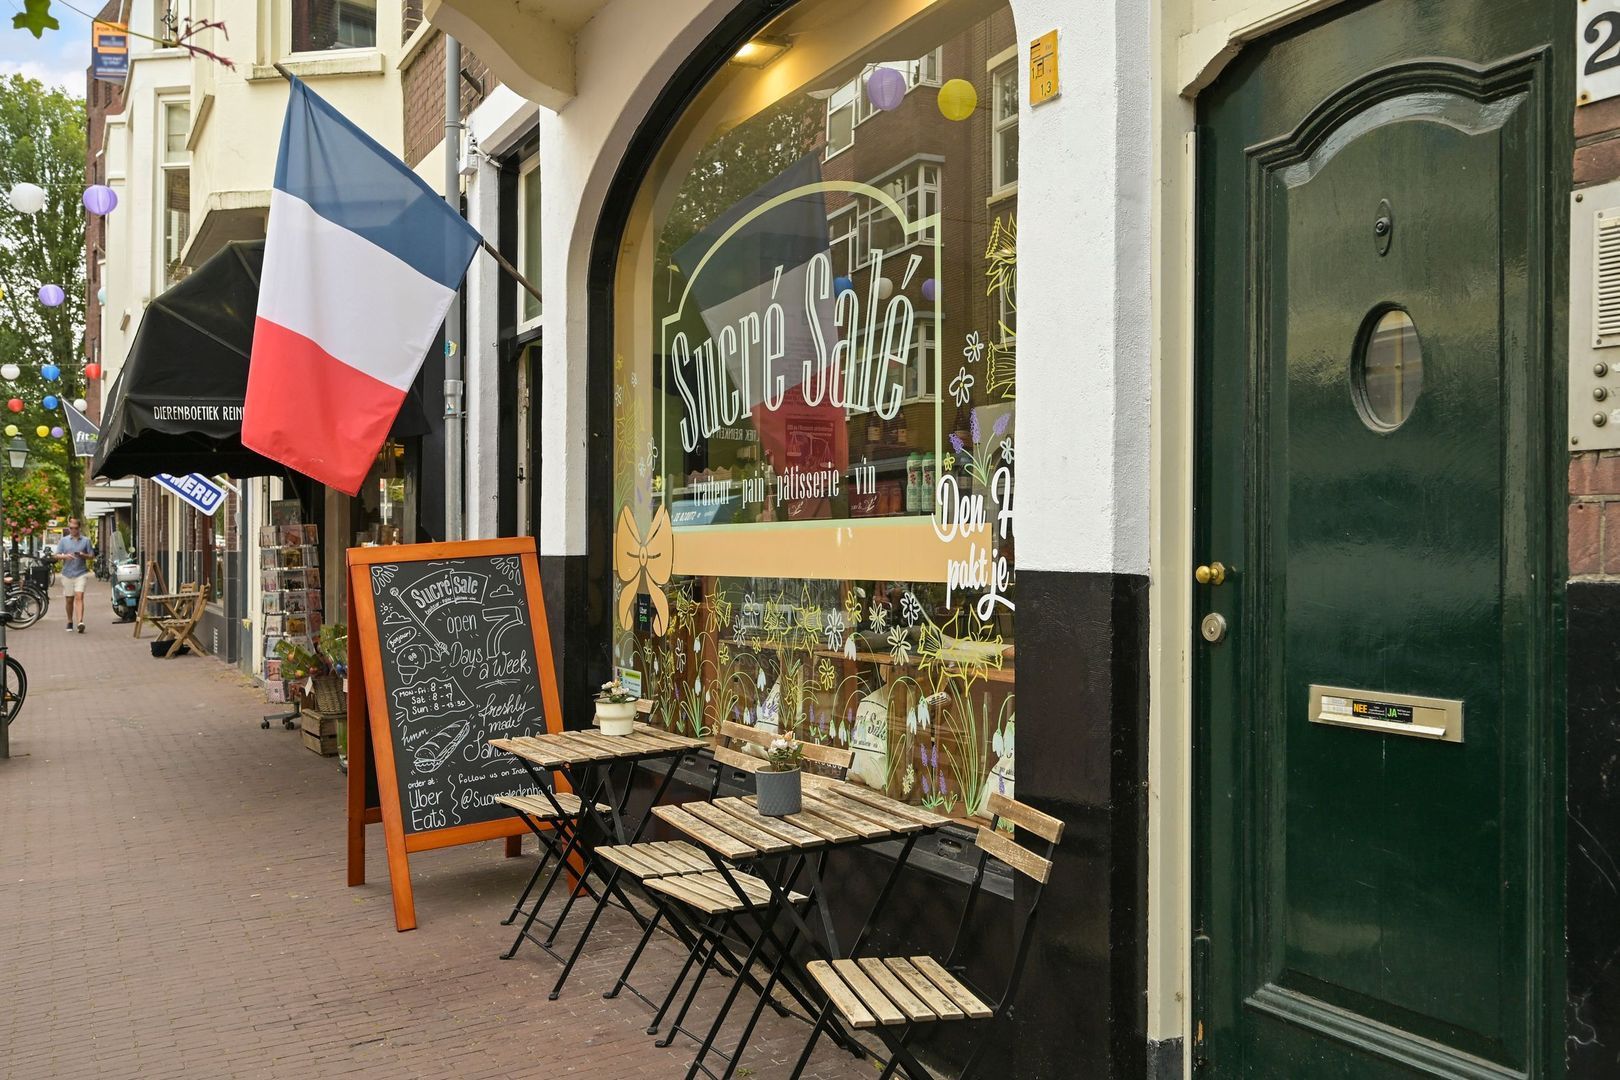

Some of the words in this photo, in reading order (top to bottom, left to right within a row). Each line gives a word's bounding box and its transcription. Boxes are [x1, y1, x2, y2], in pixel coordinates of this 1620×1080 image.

[672, 264, 785, 453] Sucré
[802, 249, 923, 421] Salé
[153, 406, 219, 420] DIERENBOETIEK
[222, 406, 245, 420] REIN
[693, 475, 731, 507] traiteur
[742, 470, 764, 509] pain
[776, 461, 840, 507] pâtisserie
[855, 457, 877, 495] vin
[931, 474, 986, 543] Den
[411, 574, 453, 608] Sucré
[482, 606, 523, 658] 7
[449, 641, 483, 677] Days
[479, 662, 489, 680] a
[492, 649, 531, 677] Week
[478, 693, 535, 726] freshly
[489, 716, 520, 733] made
[1353, 703, 1368, 714] NEE
[1387, 707, 1398, 717] JA
[408, 779, 426, 789] order
[409, 789, 443, 809] Uber
[411, 809, 446, 831] Eats
